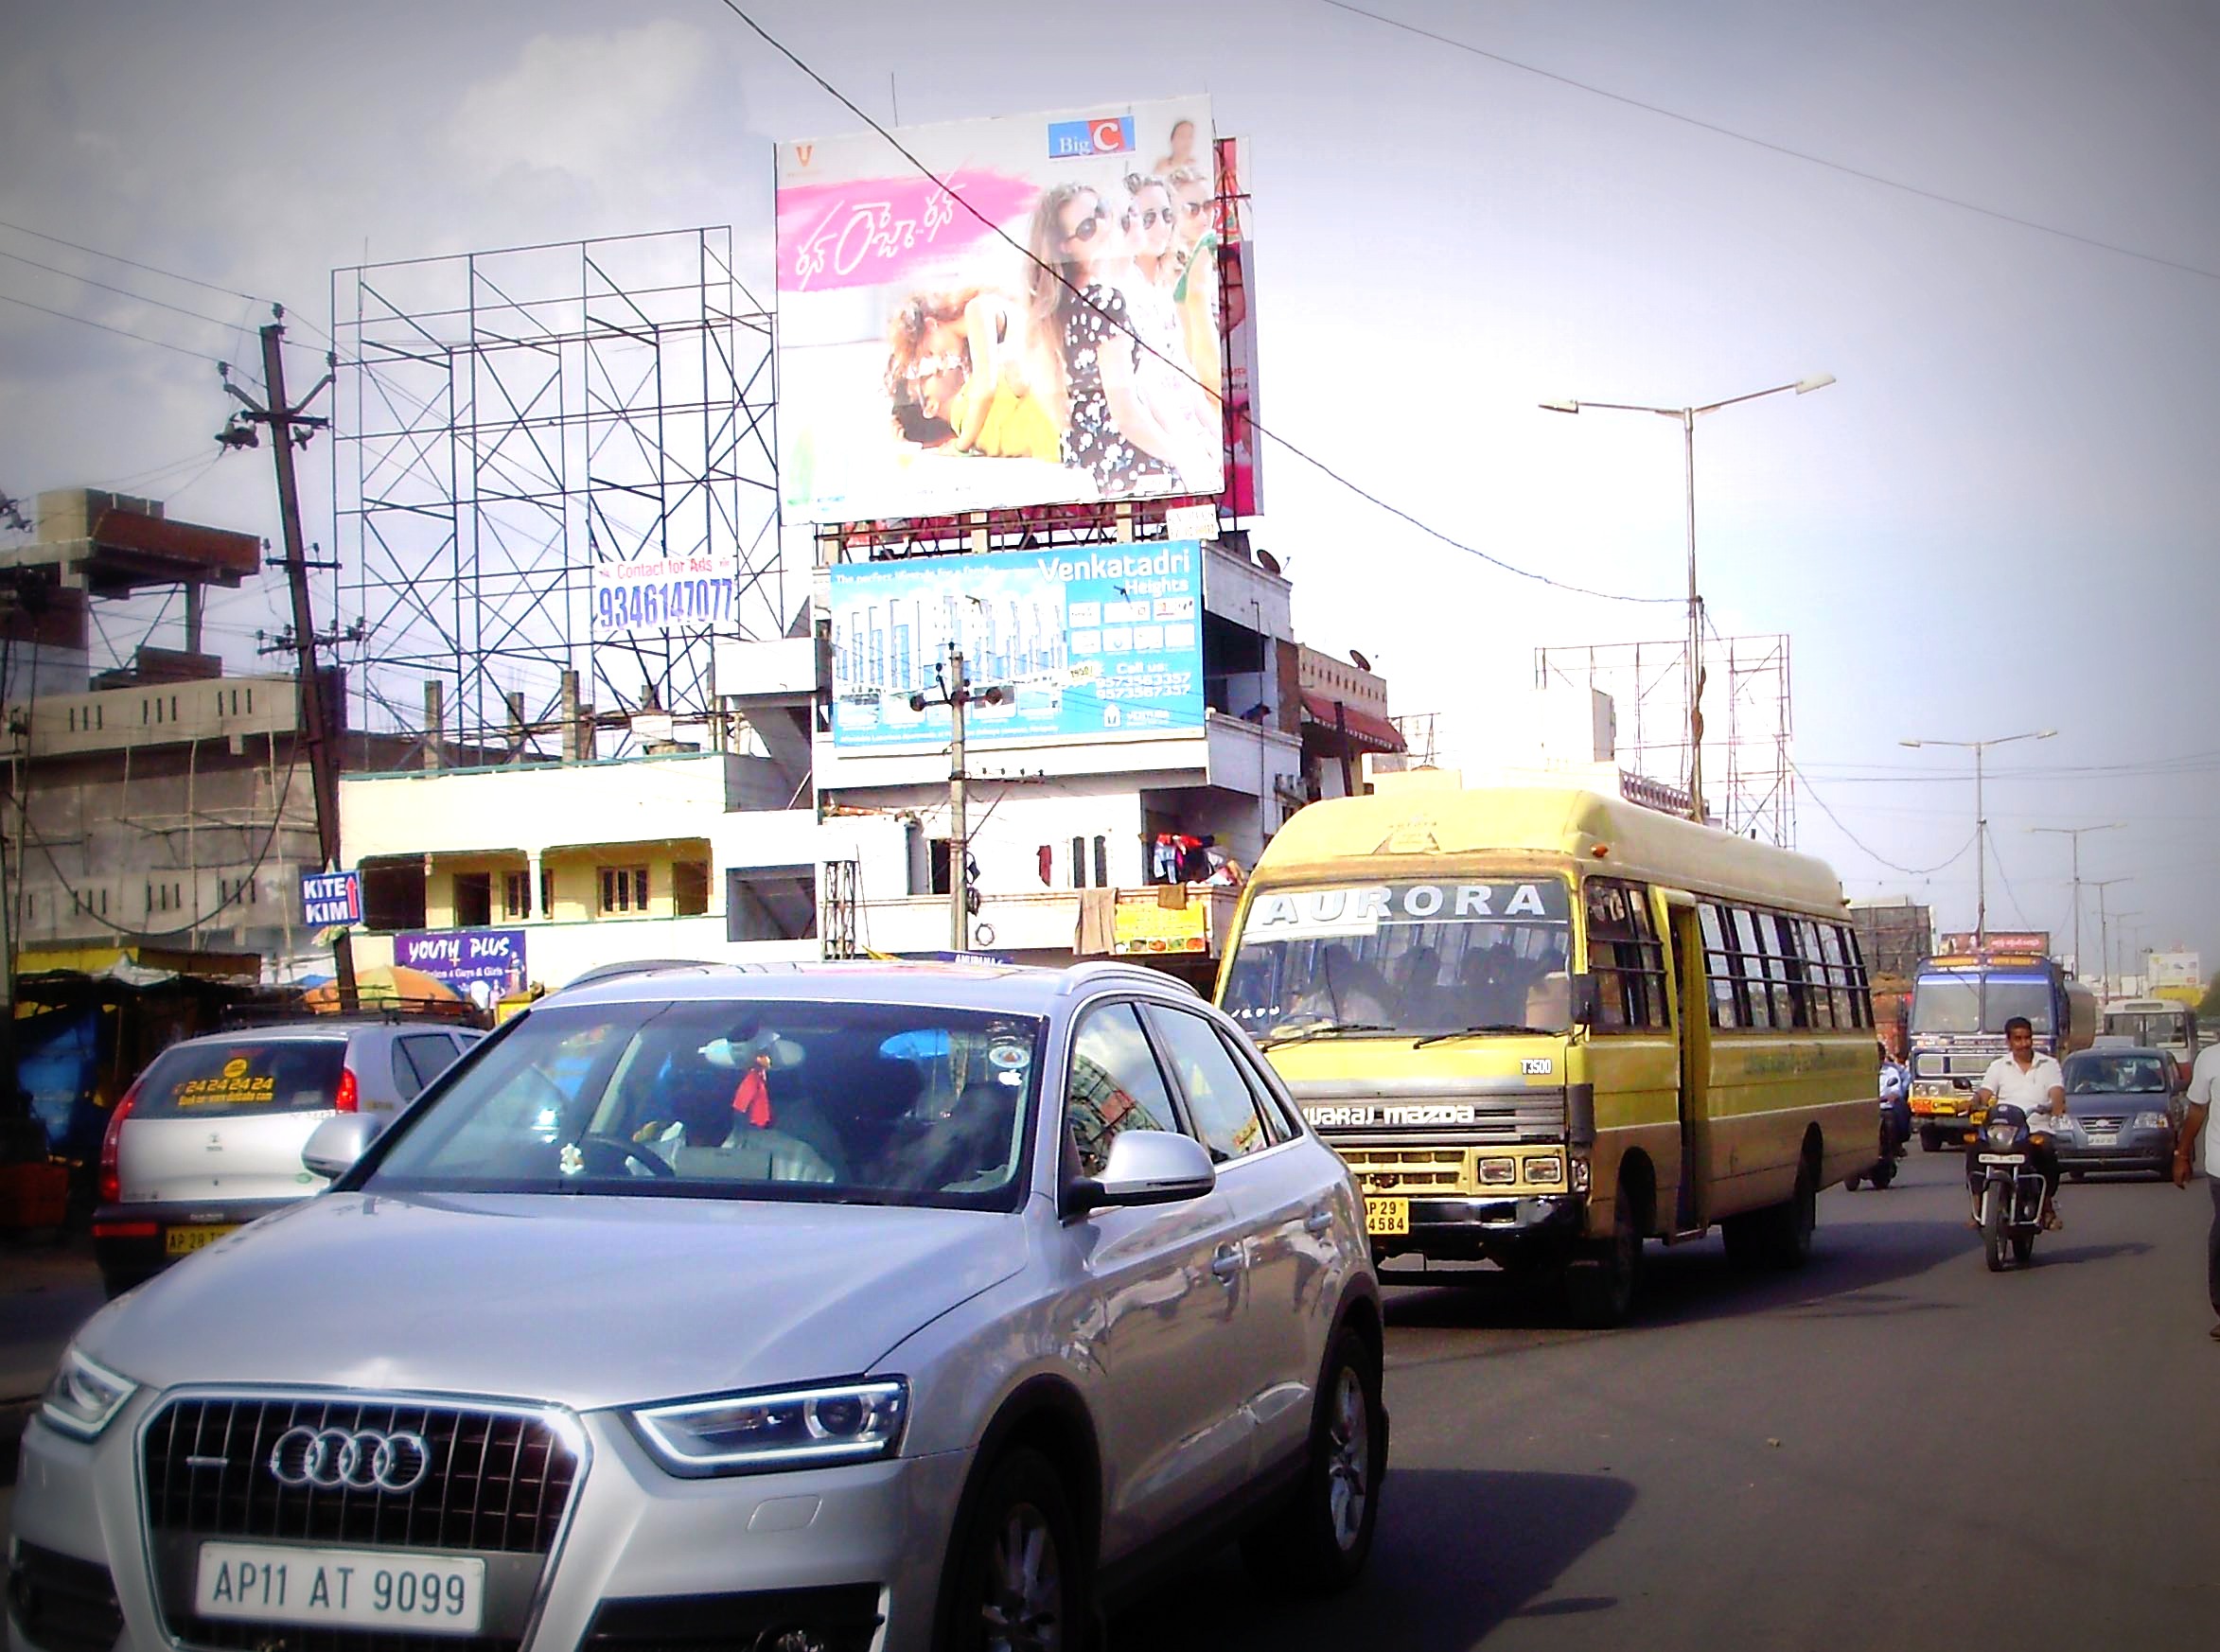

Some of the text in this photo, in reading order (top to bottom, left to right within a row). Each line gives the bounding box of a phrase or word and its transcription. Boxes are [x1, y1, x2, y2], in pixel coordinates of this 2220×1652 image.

[1060, 122, 1119, 156] Big C
[617, 558, 713, 579] Contact for Ads
[1037, 548, 1190, 583] Venkatadri
[1124, 576, 1189, 598] Heights
[599, 577, 733, 630] 9346147077
[1116, 662, 1144, 675] Call
[303, 877, 346, 900] KITE
[306, 901, 348, 923] KIM
[1261, 884, 1546, 925] AURORA
[409, 937, 510, 963] YOUTH PLUS
[1521, 1059, 1552, 1075] T3500
[185, 1077, 273, 1094] 24 24 24 24
[1302, 1104, 1475, 1126] waraj mazda
[1380, 1201, 1397, 1215] 29
[1368, 1217, 1404, 1231] 4584
[169, 1234, 185, 1249] AP
[189, 1233, 205, 1249] 28
[213, 1560, 467, 1615] AP11 AT 9099
